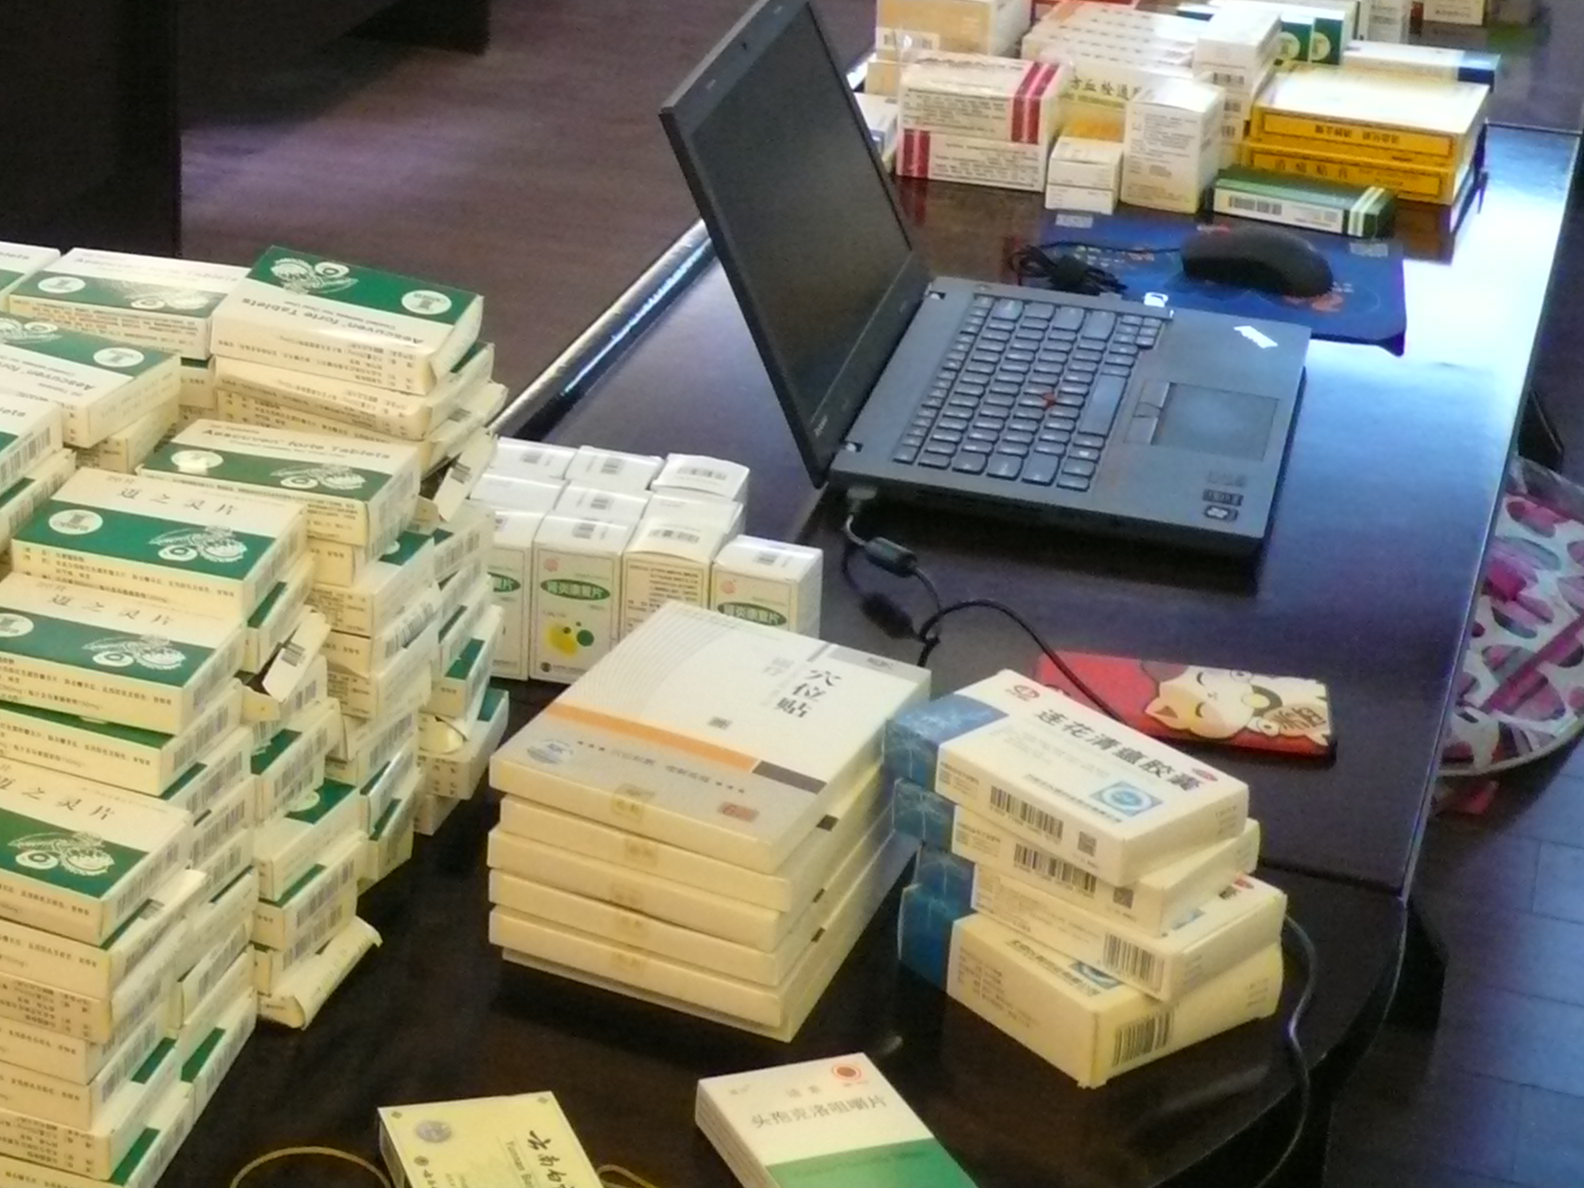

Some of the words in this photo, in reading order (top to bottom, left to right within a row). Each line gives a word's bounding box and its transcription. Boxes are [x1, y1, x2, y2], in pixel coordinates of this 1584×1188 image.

[117, 485, 238, 517] 迈之灵片
[48, 593, 175, 627] 迈之灵片
[774, 668, 842, 719] 穴位贴
[1036, 708, 1203, 792] 连花清瘟胶囊
[751, 1095, 887, 1128] 头孢克洛咀嚼片
